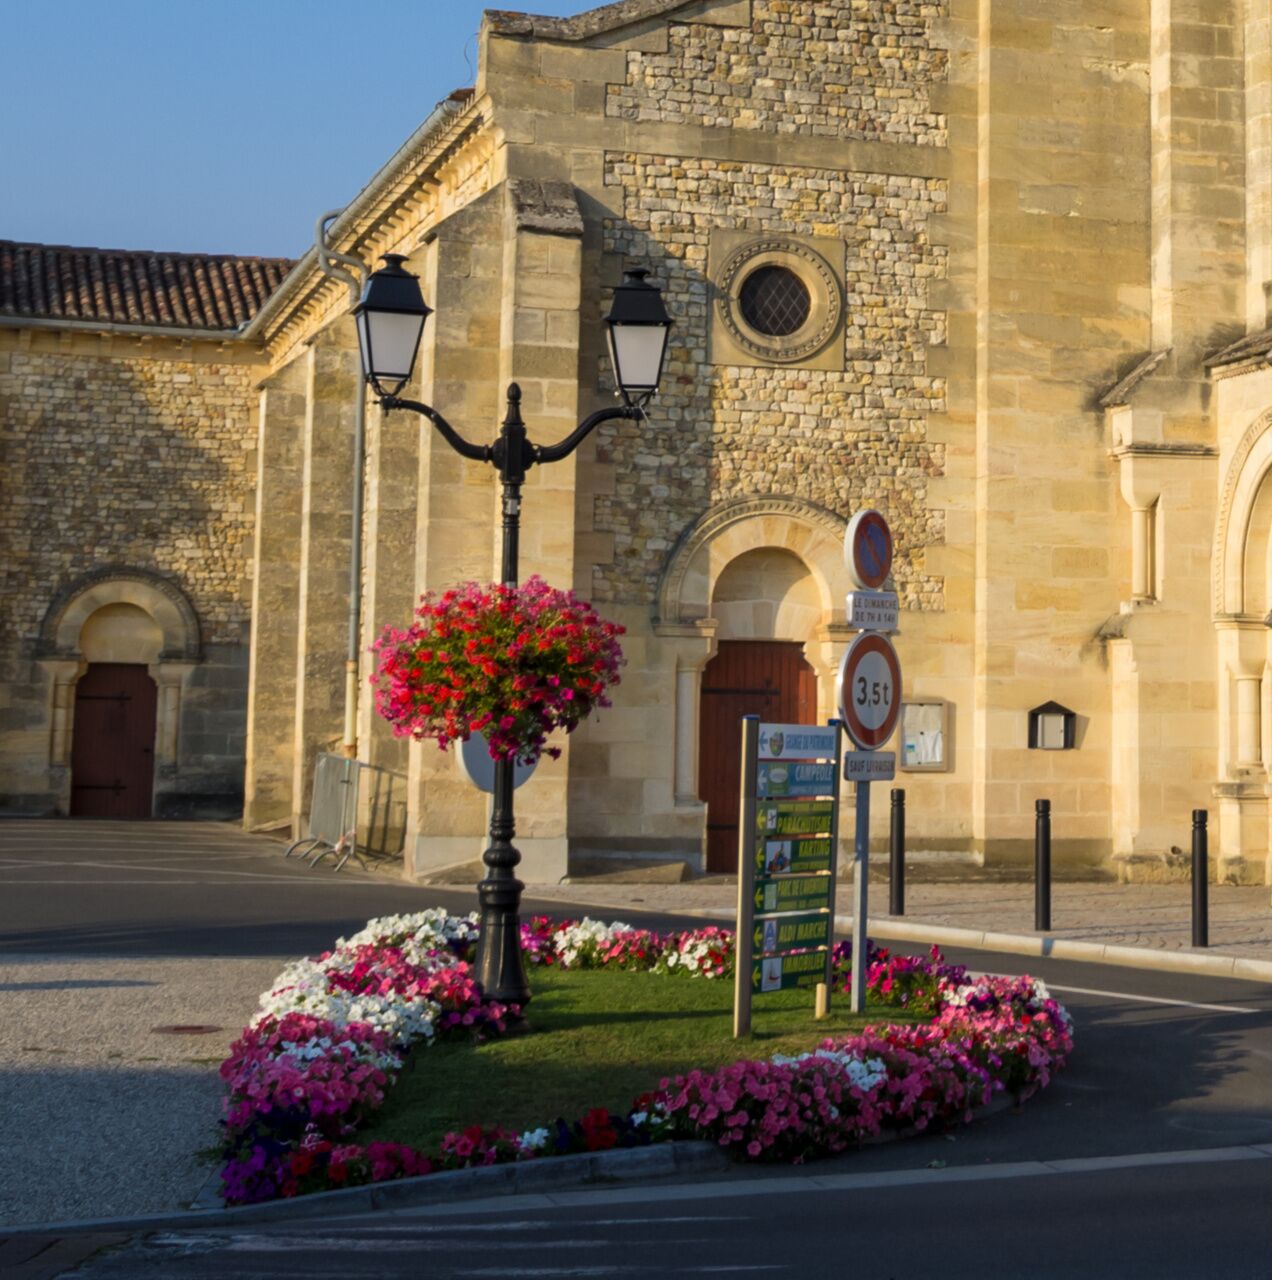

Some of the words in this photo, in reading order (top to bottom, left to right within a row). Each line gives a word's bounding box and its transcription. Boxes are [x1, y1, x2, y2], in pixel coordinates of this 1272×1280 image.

[853, 598, 862, 608] LE
[864, 598, 897, 609] DIMANCHE
[855, 611, 864, 622] DE
[857, 676, 880, 707] 3,5
[883, 682, 889, 705] t
[850, 760, 865, 772] SAUF
[799, 840, 831, 856] KARTING
[778, 925, 797, 943] ALDI
